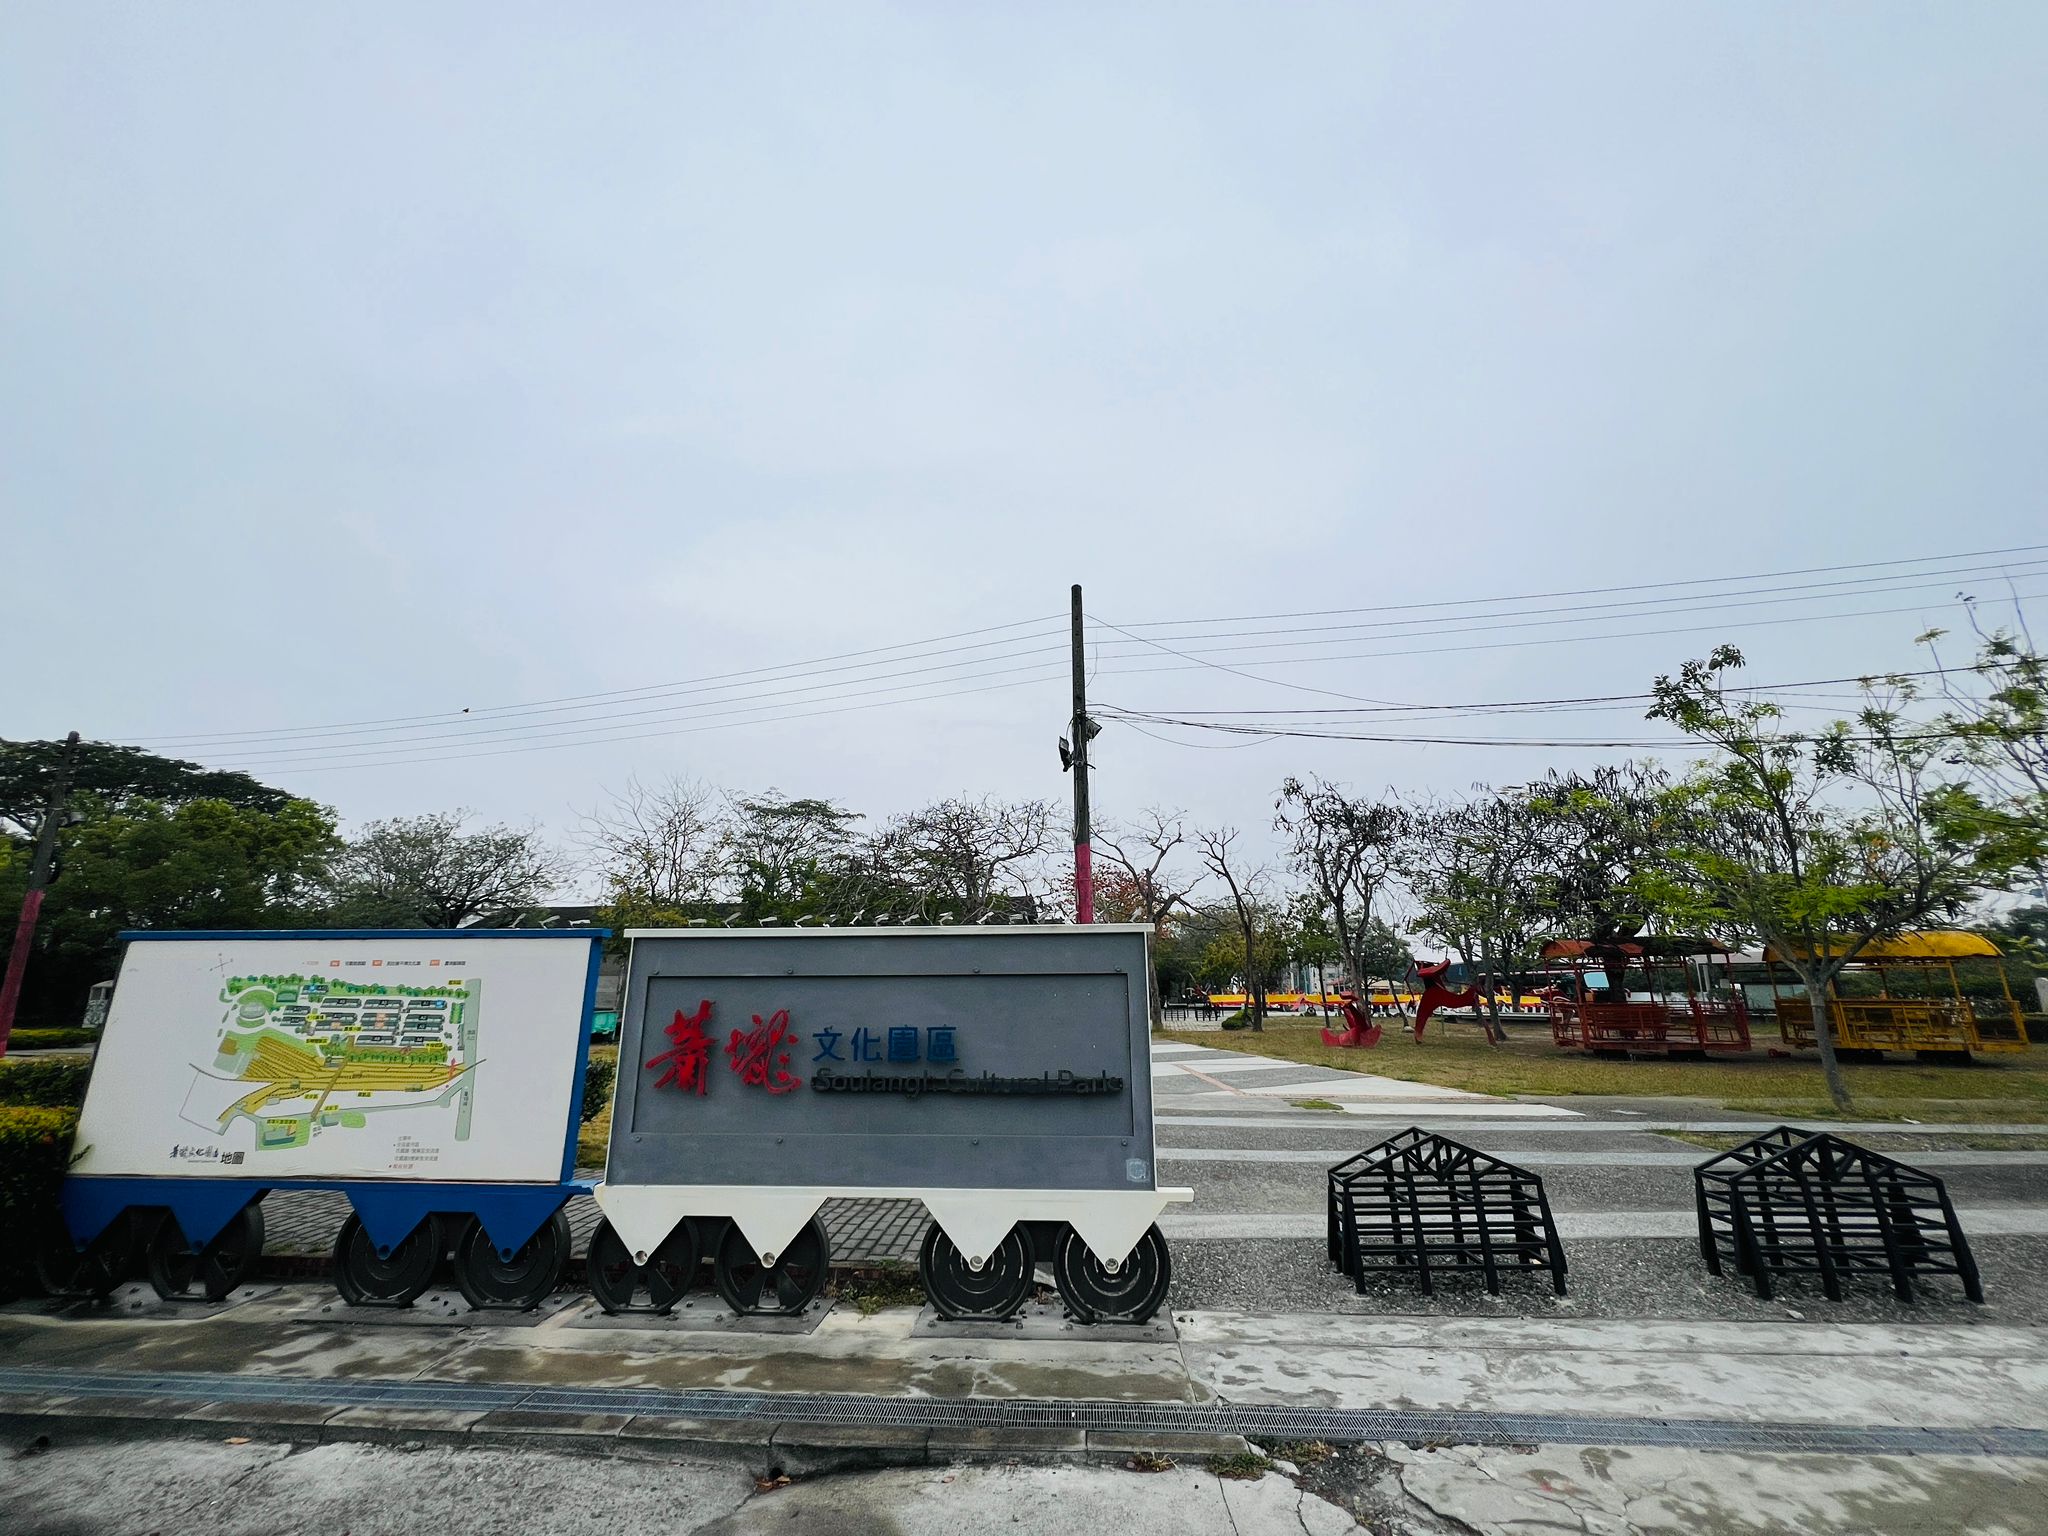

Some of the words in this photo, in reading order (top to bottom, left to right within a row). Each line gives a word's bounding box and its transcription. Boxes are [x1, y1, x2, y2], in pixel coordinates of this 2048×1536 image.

[812, 1025, 959, 1064] 文化園區
[1058, 1069, 1123, 1093] Park
